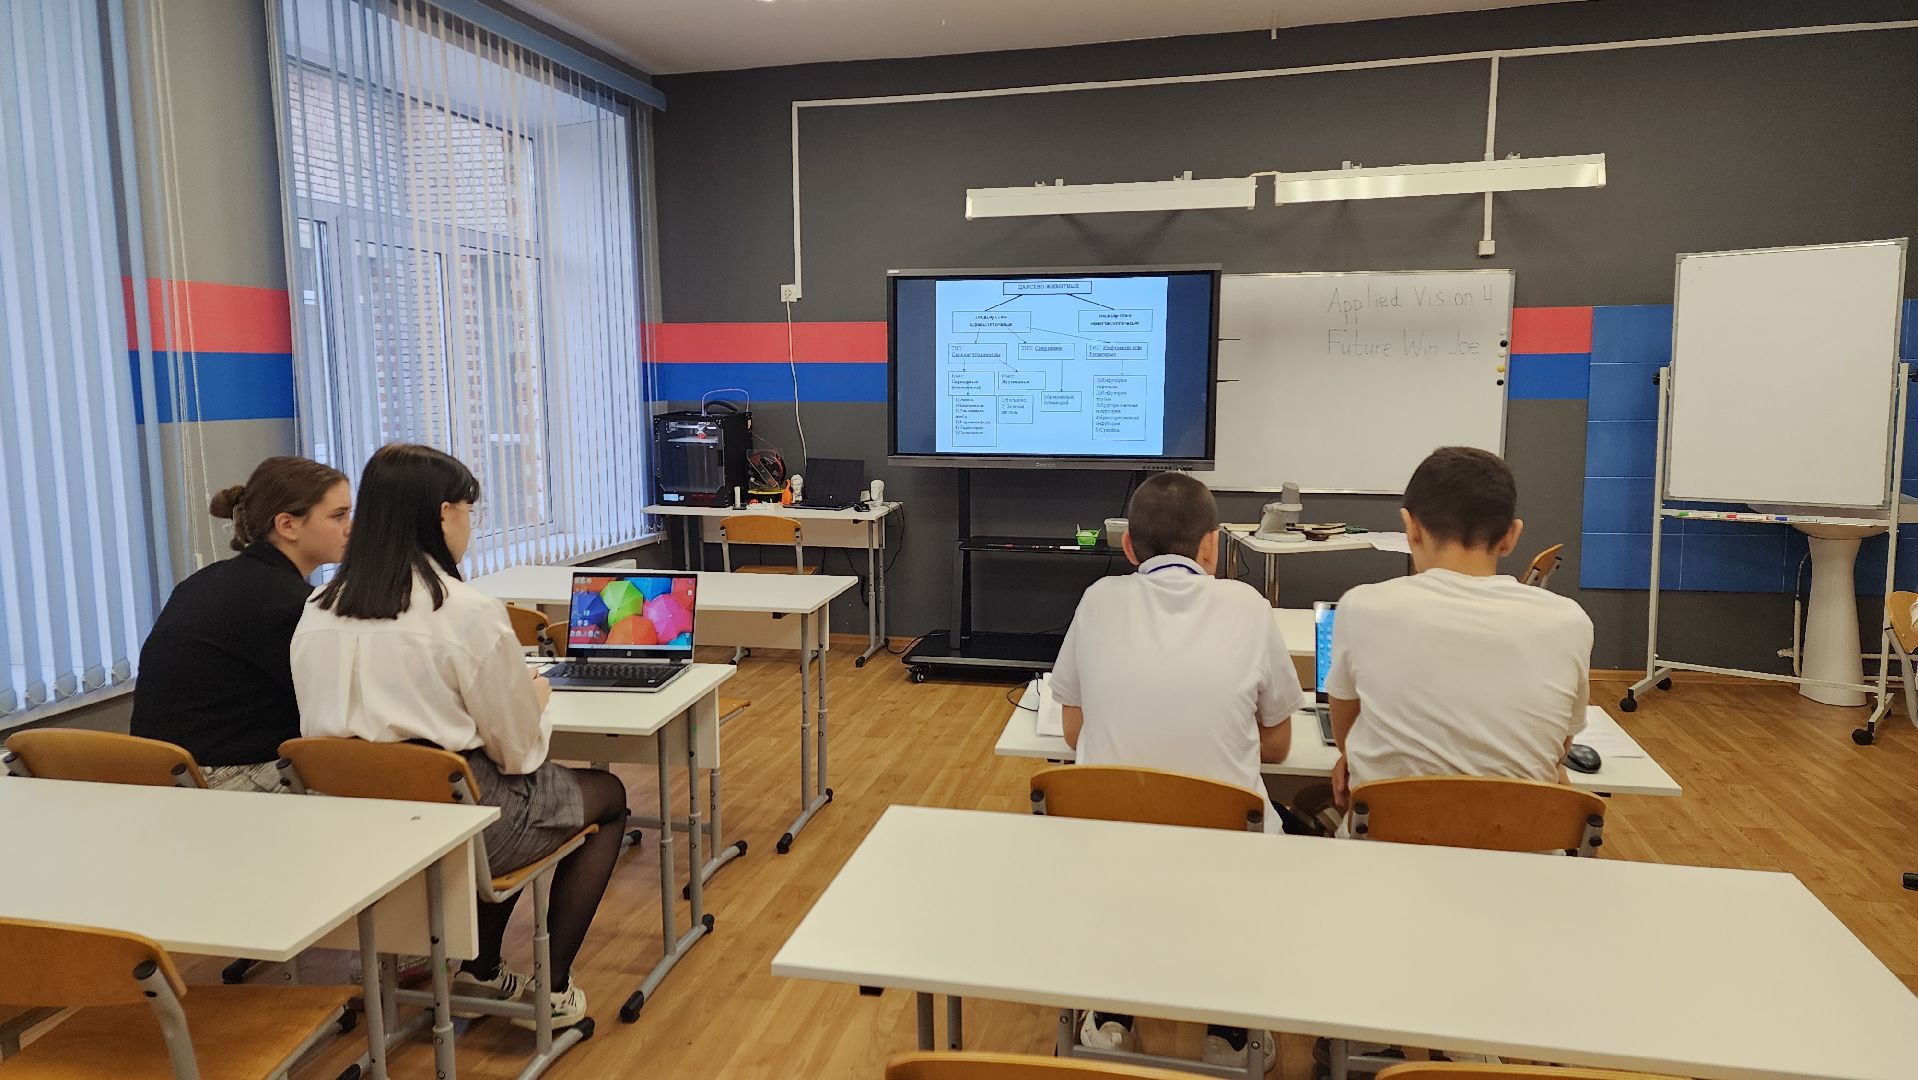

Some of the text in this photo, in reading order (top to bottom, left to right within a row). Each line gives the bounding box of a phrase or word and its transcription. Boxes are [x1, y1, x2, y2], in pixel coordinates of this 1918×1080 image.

[1327, 283, 1494, 325] Applied Vision 4
[1327, 328, 1481, 358] Future Win Joe
